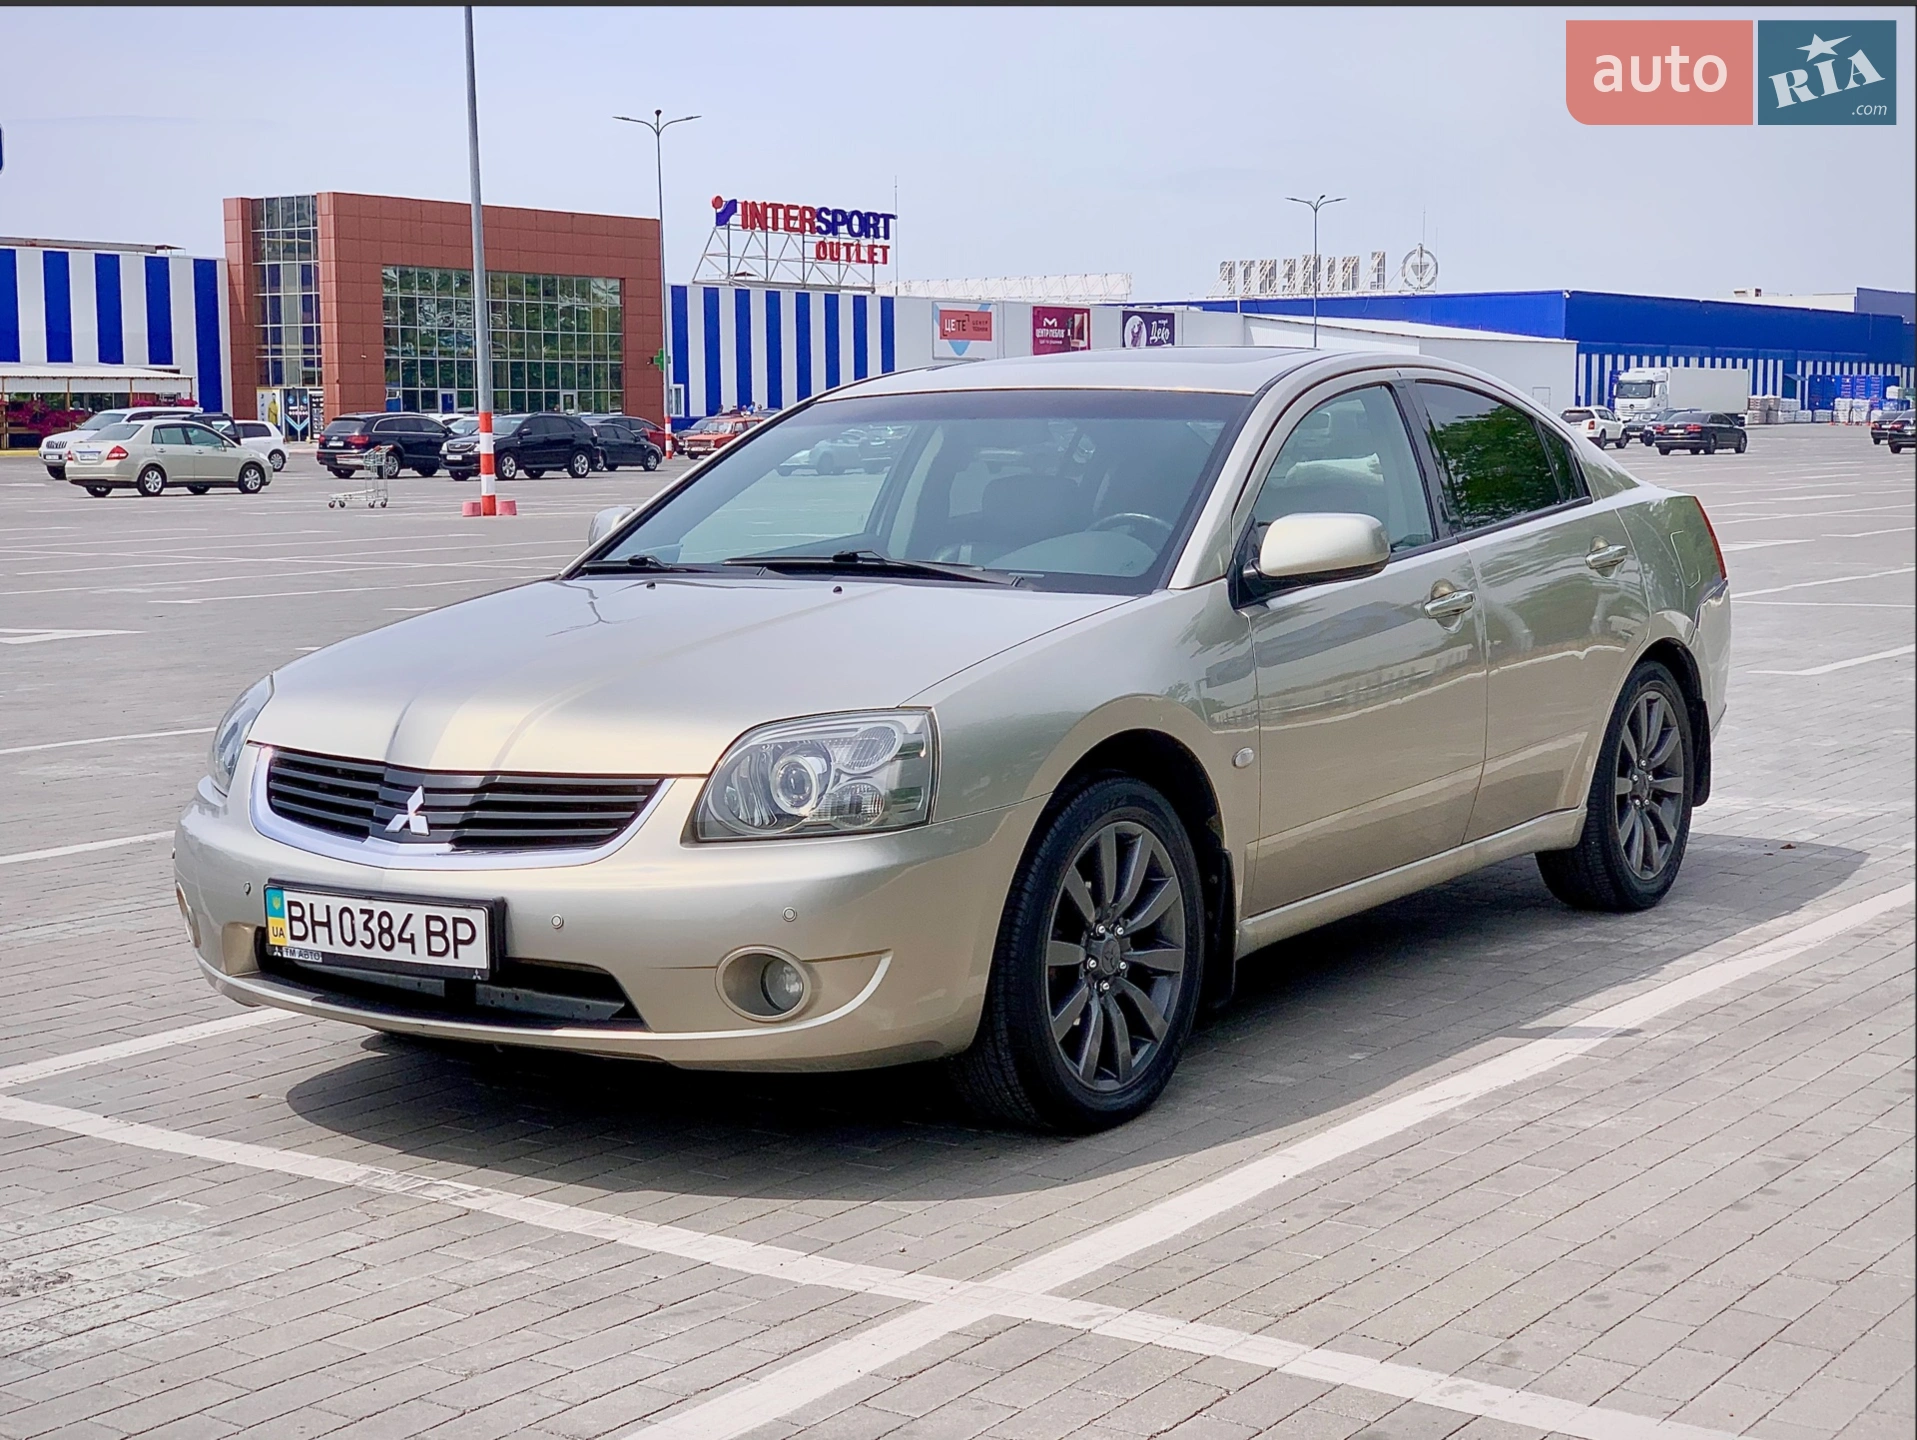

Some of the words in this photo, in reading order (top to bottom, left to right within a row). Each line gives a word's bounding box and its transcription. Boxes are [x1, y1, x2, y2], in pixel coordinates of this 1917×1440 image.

[740, 199, 898, 240] INTERSPORT
[815, 240, 891, 265] OUTLET
[272, 926, 286, 939] UA
